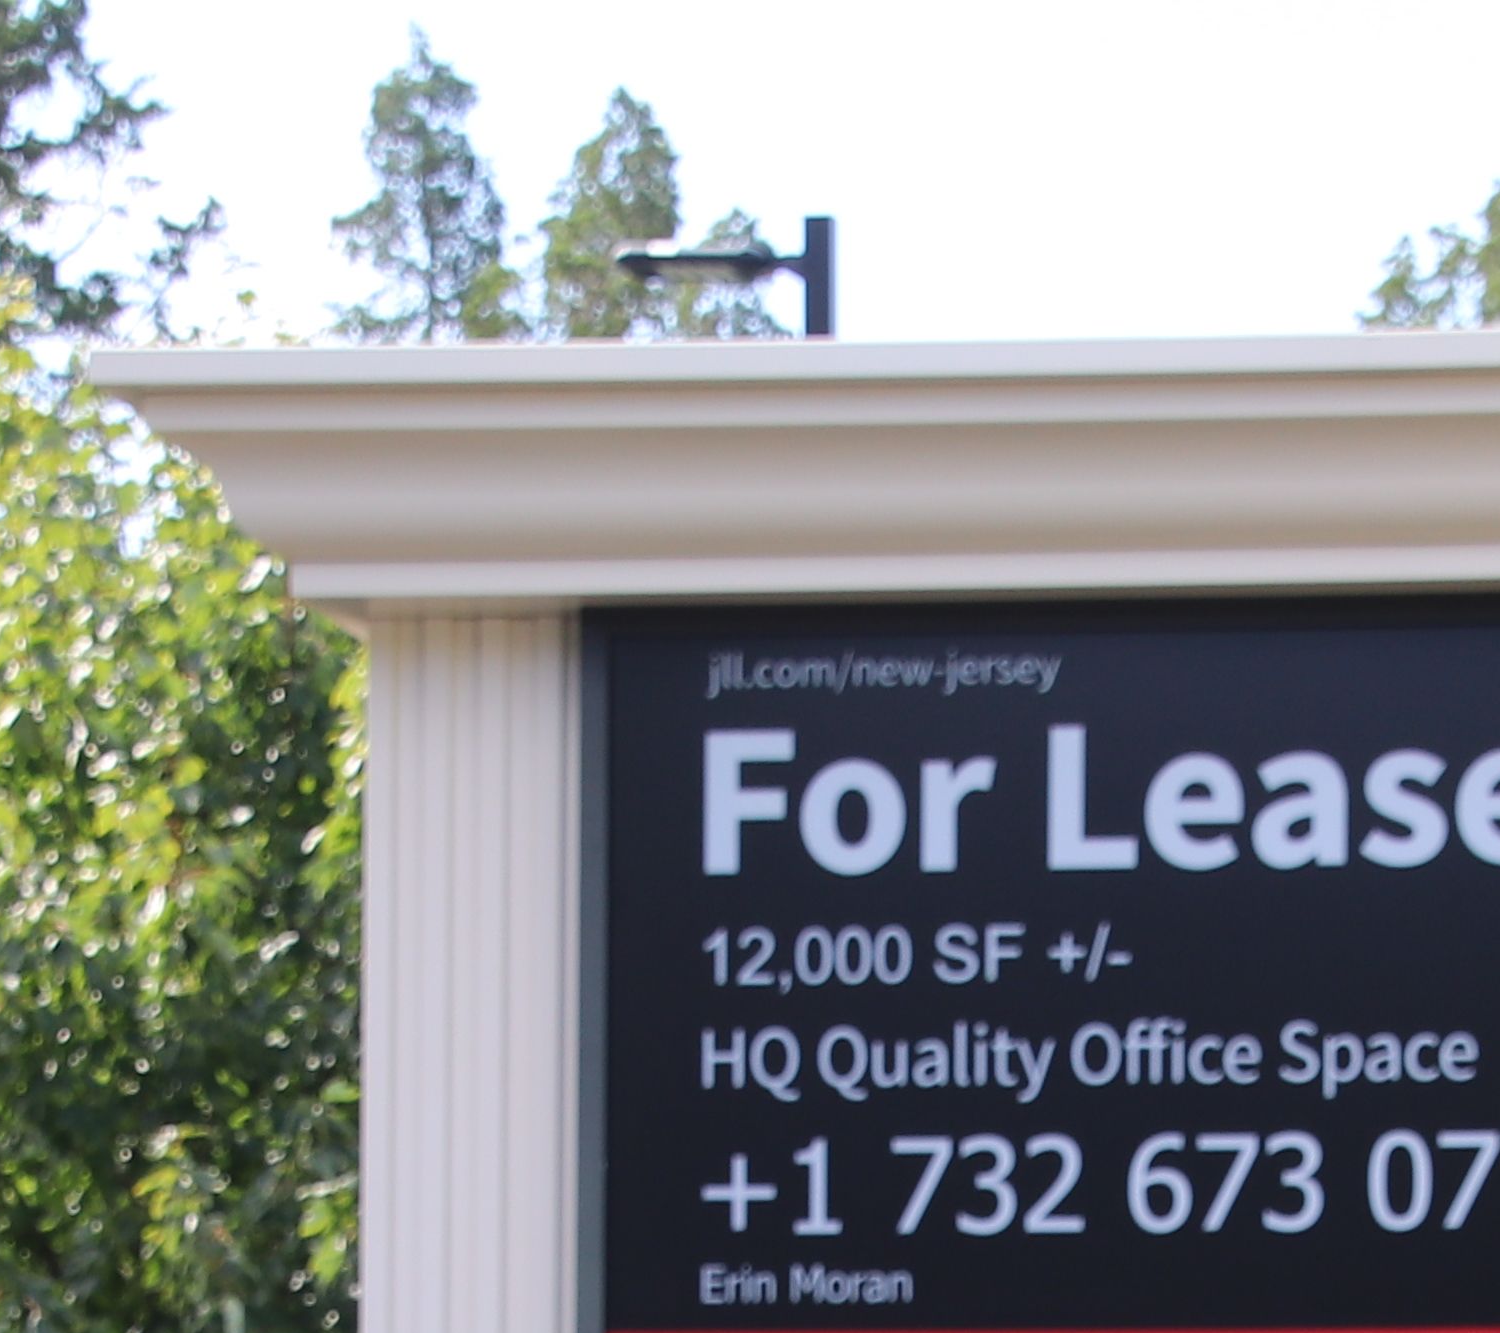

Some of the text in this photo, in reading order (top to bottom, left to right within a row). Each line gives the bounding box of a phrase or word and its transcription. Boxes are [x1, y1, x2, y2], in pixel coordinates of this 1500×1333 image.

[706, 650, 1062, 699] jll.com/new-jersey
[702, 728, 997, 877] For
[701, 921, 1134, 993] 12,000 SF +/-
[701, 1018, 1480, 1103] HQ Quality Office Space
[702, 1137, 843, 1237] +1
[889, 1133, 1086, 1237] 732
[1126, 1130, 1325, 1236] 673
[700, 1263, 913, 1305] Erin Moran
